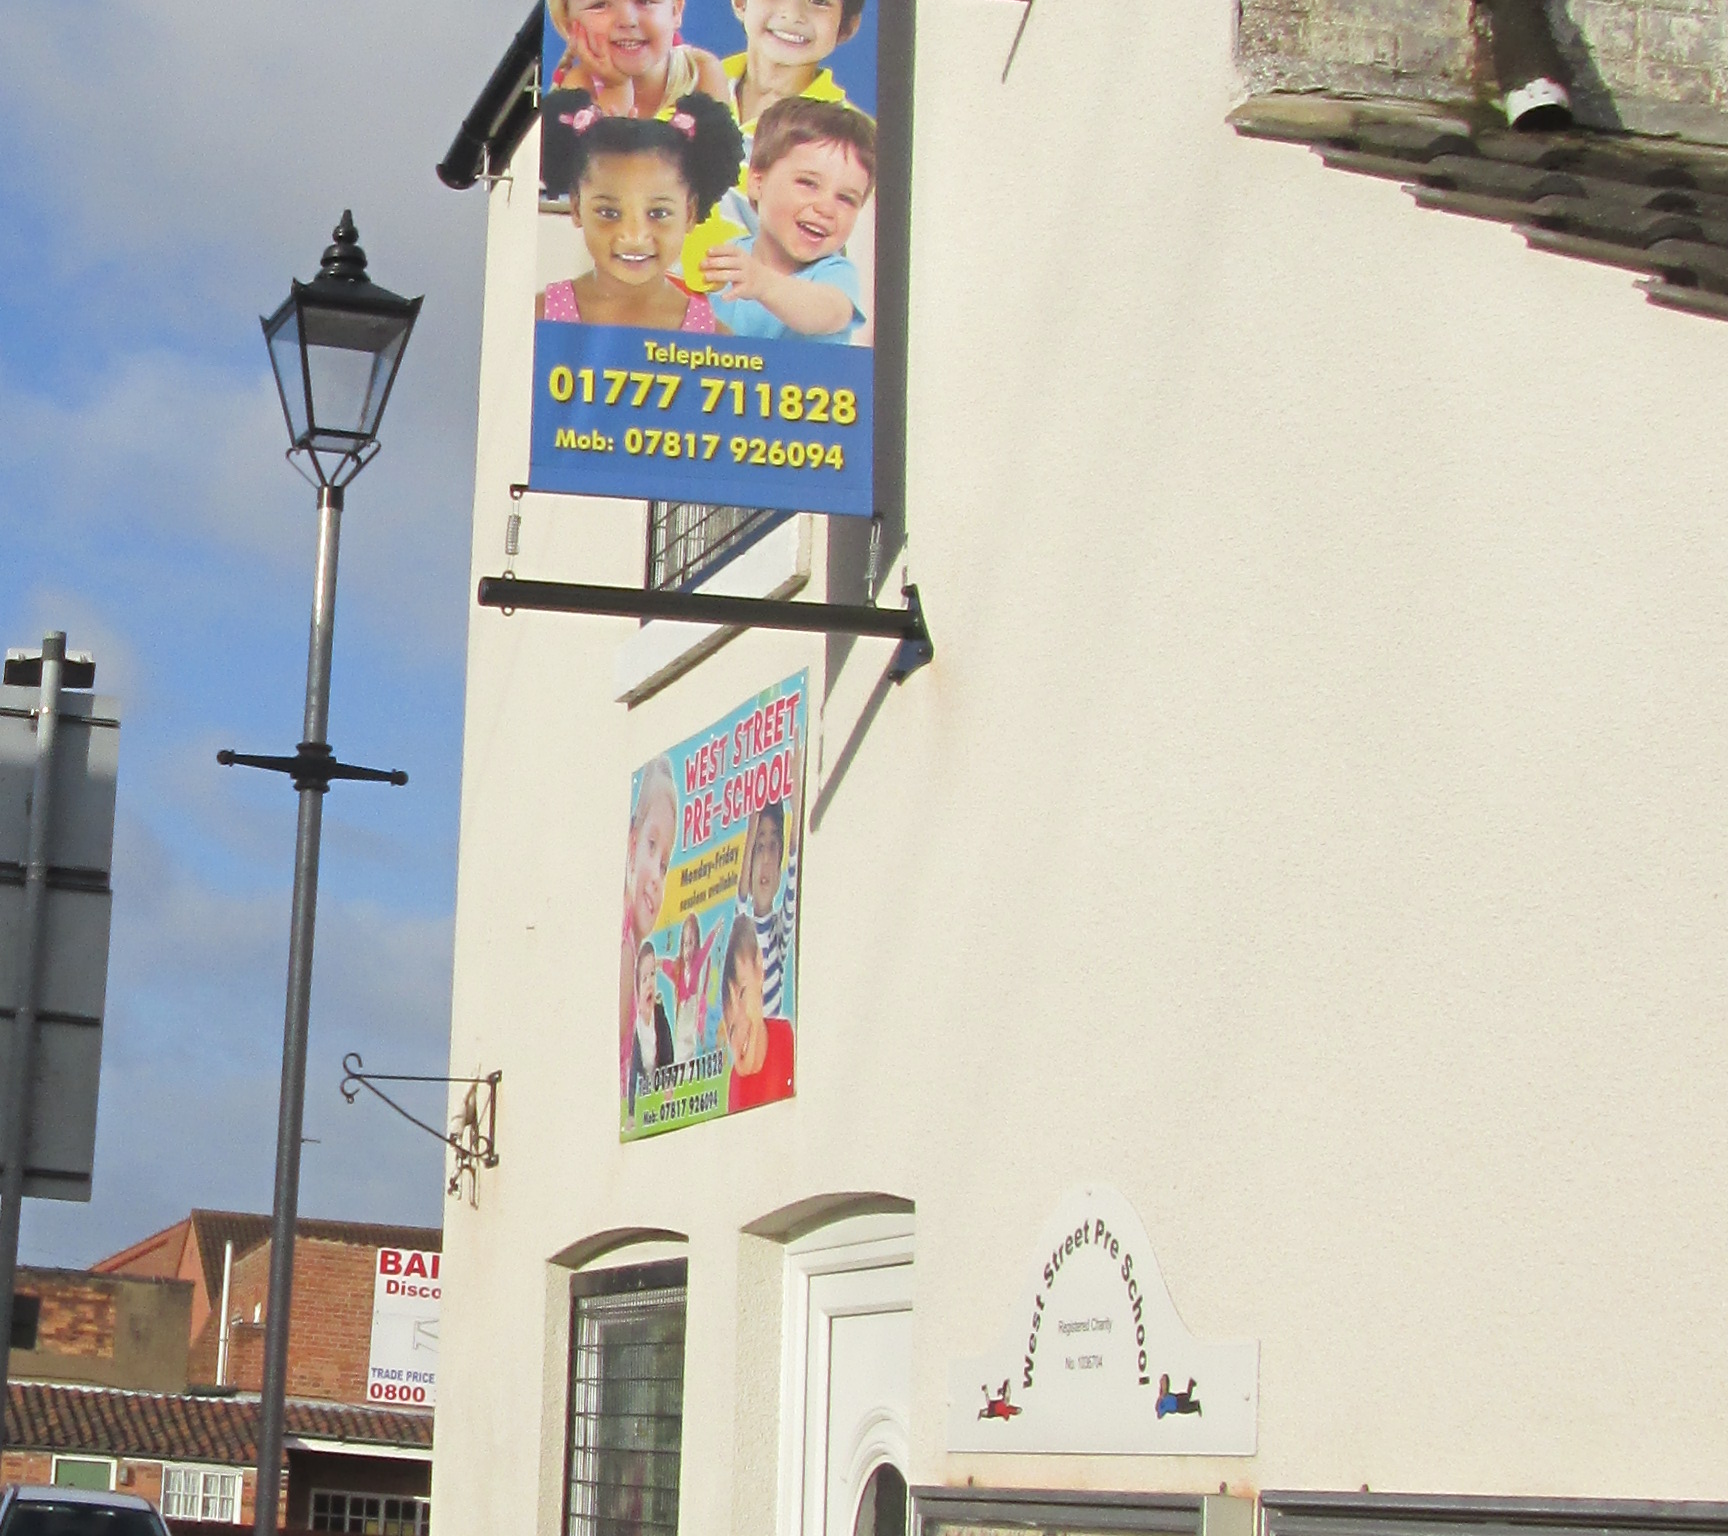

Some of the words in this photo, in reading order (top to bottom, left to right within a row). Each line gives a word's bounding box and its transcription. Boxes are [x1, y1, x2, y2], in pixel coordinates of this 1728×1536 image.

[644, 340, 764, 370] Telephone
[548, 366, 681, 409] 01777
[700, 378, 857, 425] 711828
[554, 427, 614, 451] Mob:
[624, 427, 720, 461] 07817
[729, 437, 844, 470] 926094
[683, 731, 729, 796] WEST
[732, 691, 800, 768] STREET
[681, 746, 793, 853] PRE-SCHOOL
[654, 1063, 686, 1093] 01777
[688, 1050, 724, 1084] 711828
[659, 1099, 687, 1122] 07817
[1023, 1294, 1045, 1388] West
[1043, 1220, 1090, 1289] Street
[1094, 1218, 1119, 1260] Pre
[1121, 1253, 1150, 1386] School
[370, 1383, 426, 1402] 0800
[372, 1367, 404, 1381] TRADE
